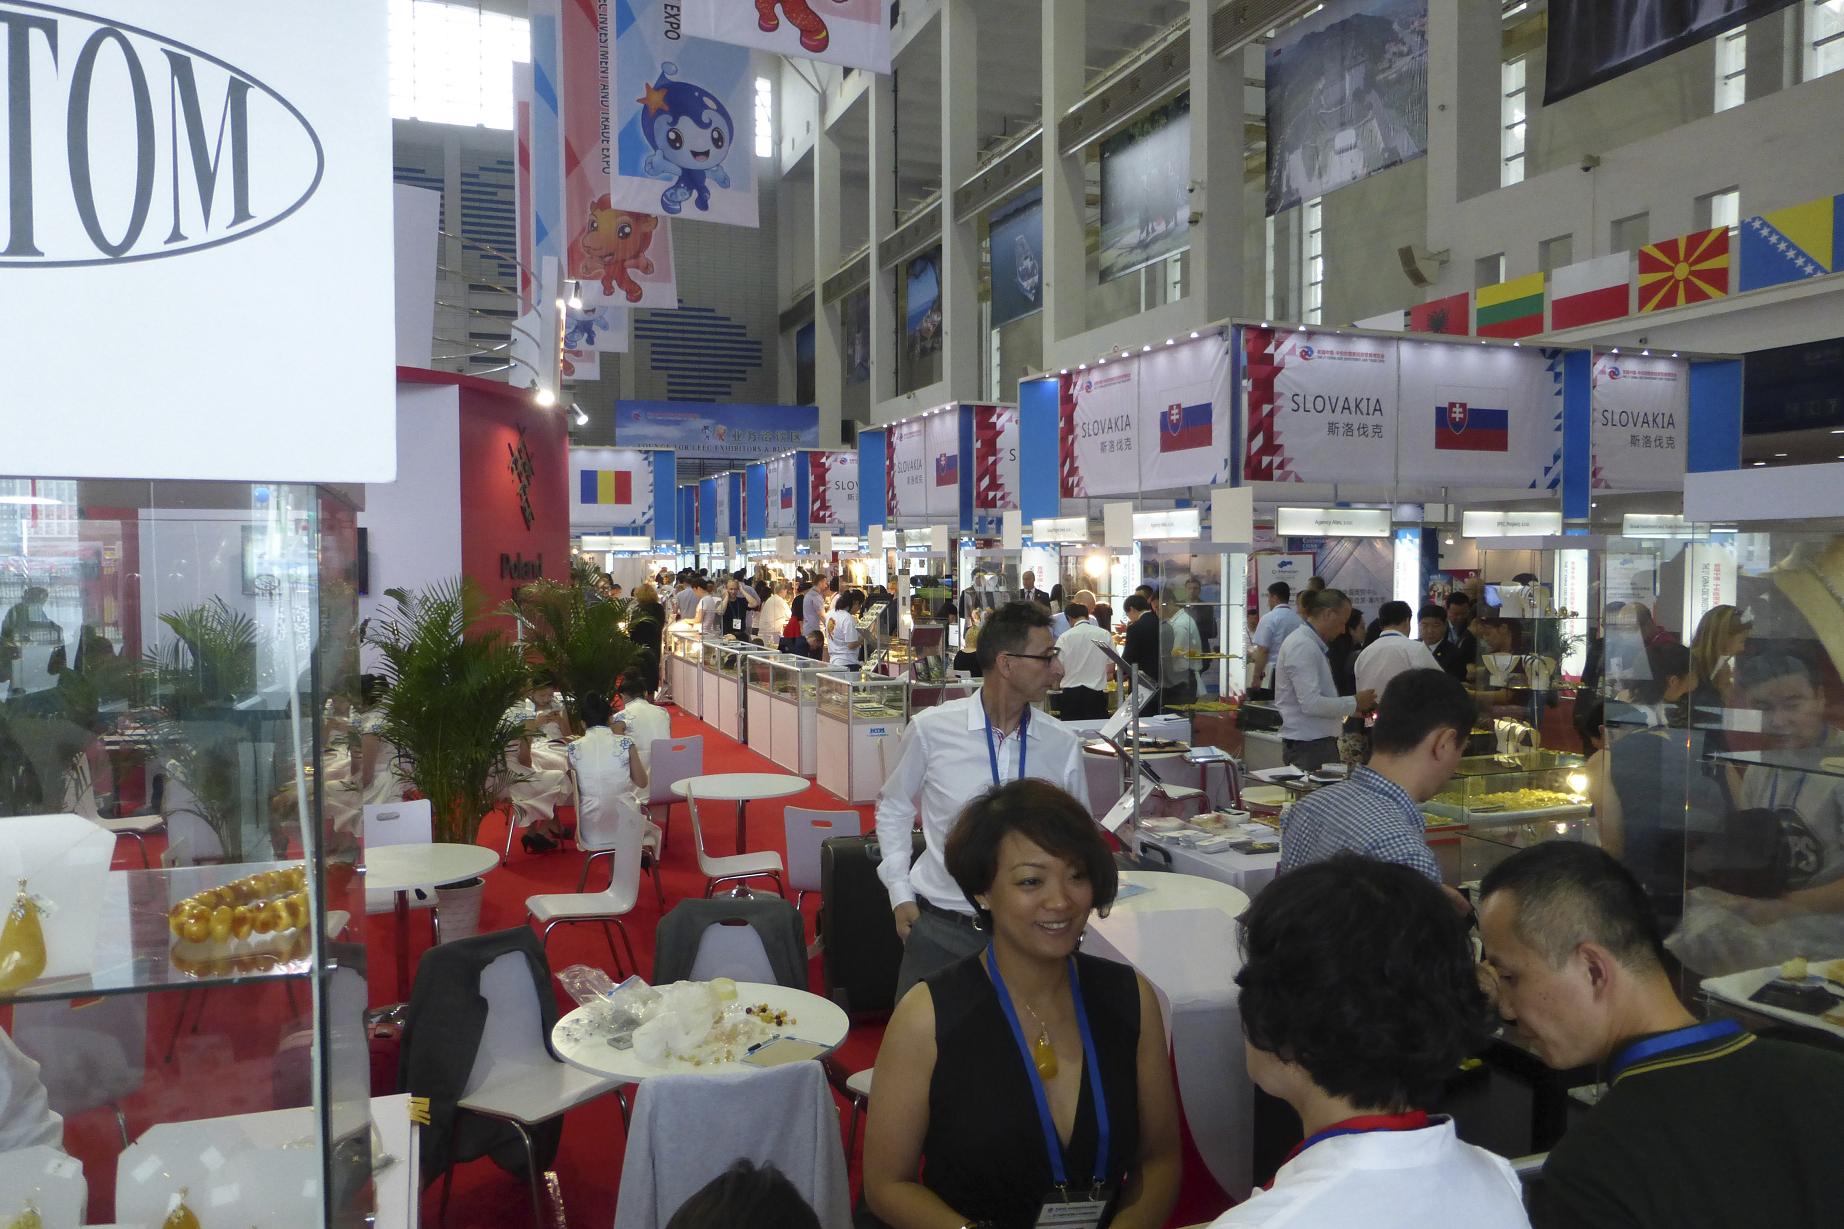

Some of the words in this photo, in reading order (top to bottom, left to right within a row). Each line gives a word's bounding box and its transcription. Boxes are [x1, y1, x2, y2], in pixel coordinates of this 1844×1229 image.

[664, 3, 681, 41] EXPO
[1291, 393, 1384, 417] SLOVAKIA
[1081, 413, 1132, 439] SLOVAKIA
[1601, 409, 1676, 429] SLOVAKIA
[1327, 421, 1384, 440] 斯洛伐克
[1630, 434, 1676, 449] 斯洛伐克
[897, 458, 923, 474] SLOVAKIA
